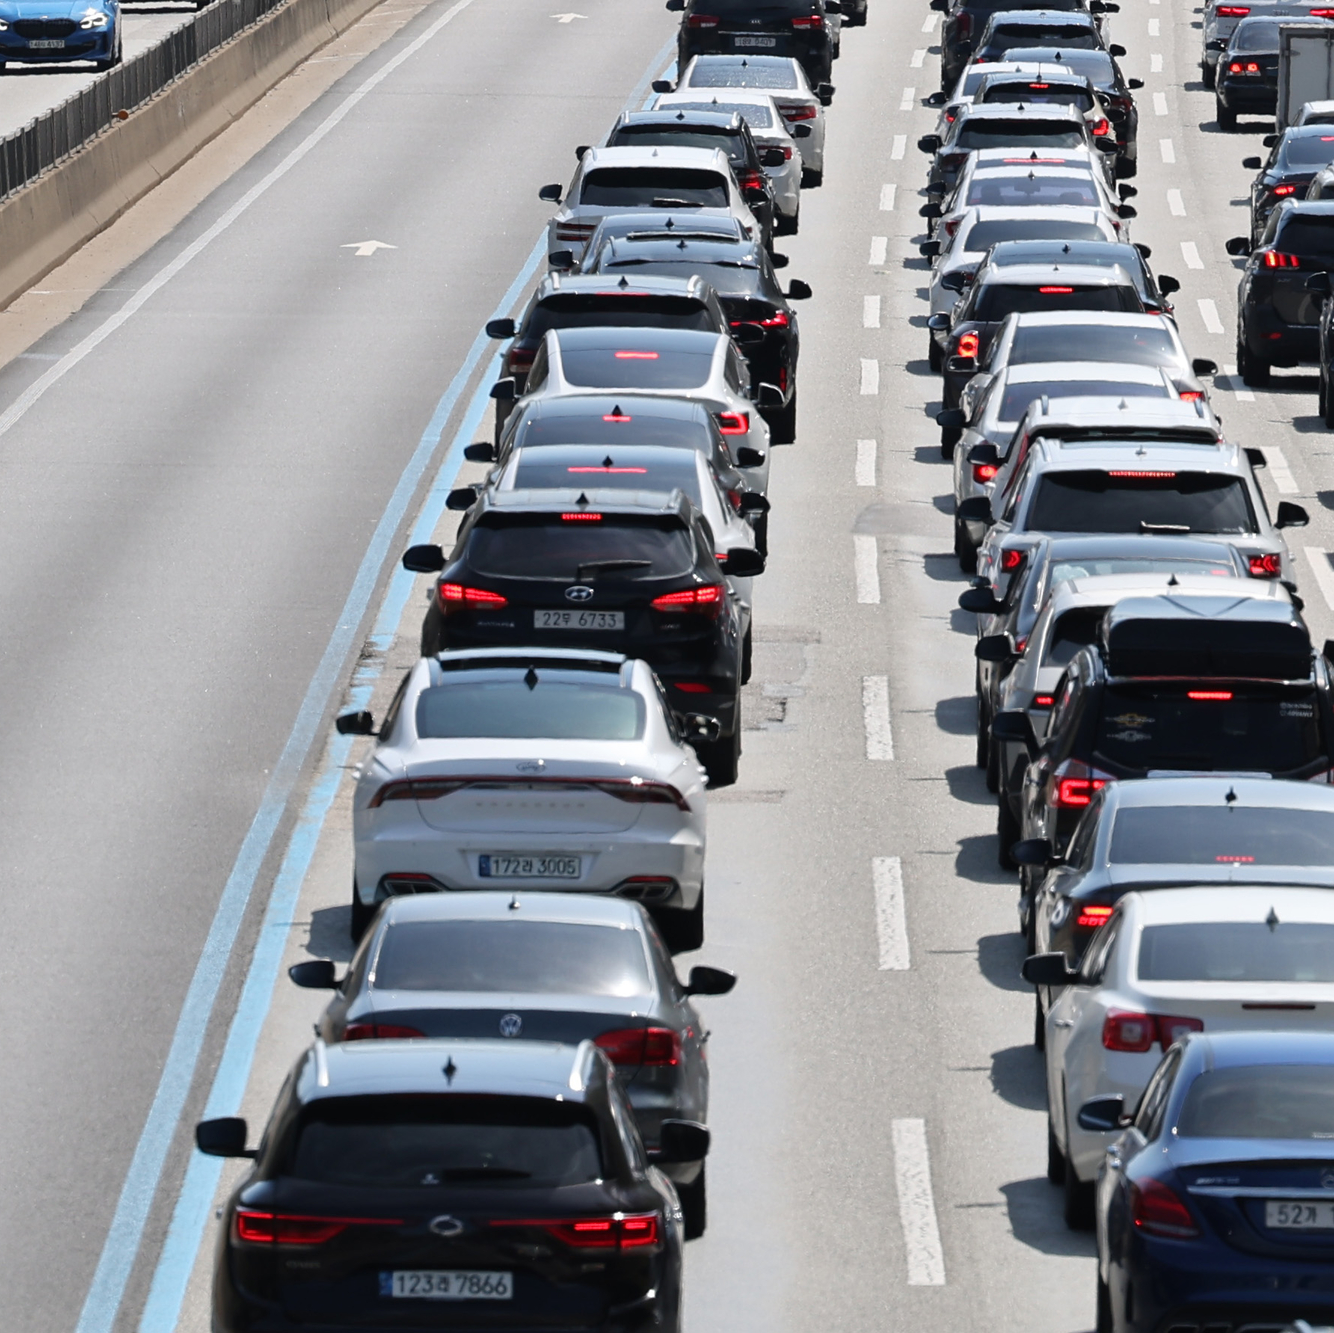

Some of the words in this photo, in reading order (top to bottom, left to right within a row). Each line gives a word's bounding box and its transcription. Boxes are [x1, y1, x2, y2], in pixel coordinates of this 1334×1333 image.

[578, 612, 617, 628] 6733
[537, 858, 576, 875] 3005
[456, 1274, 508, 1296] 7866
